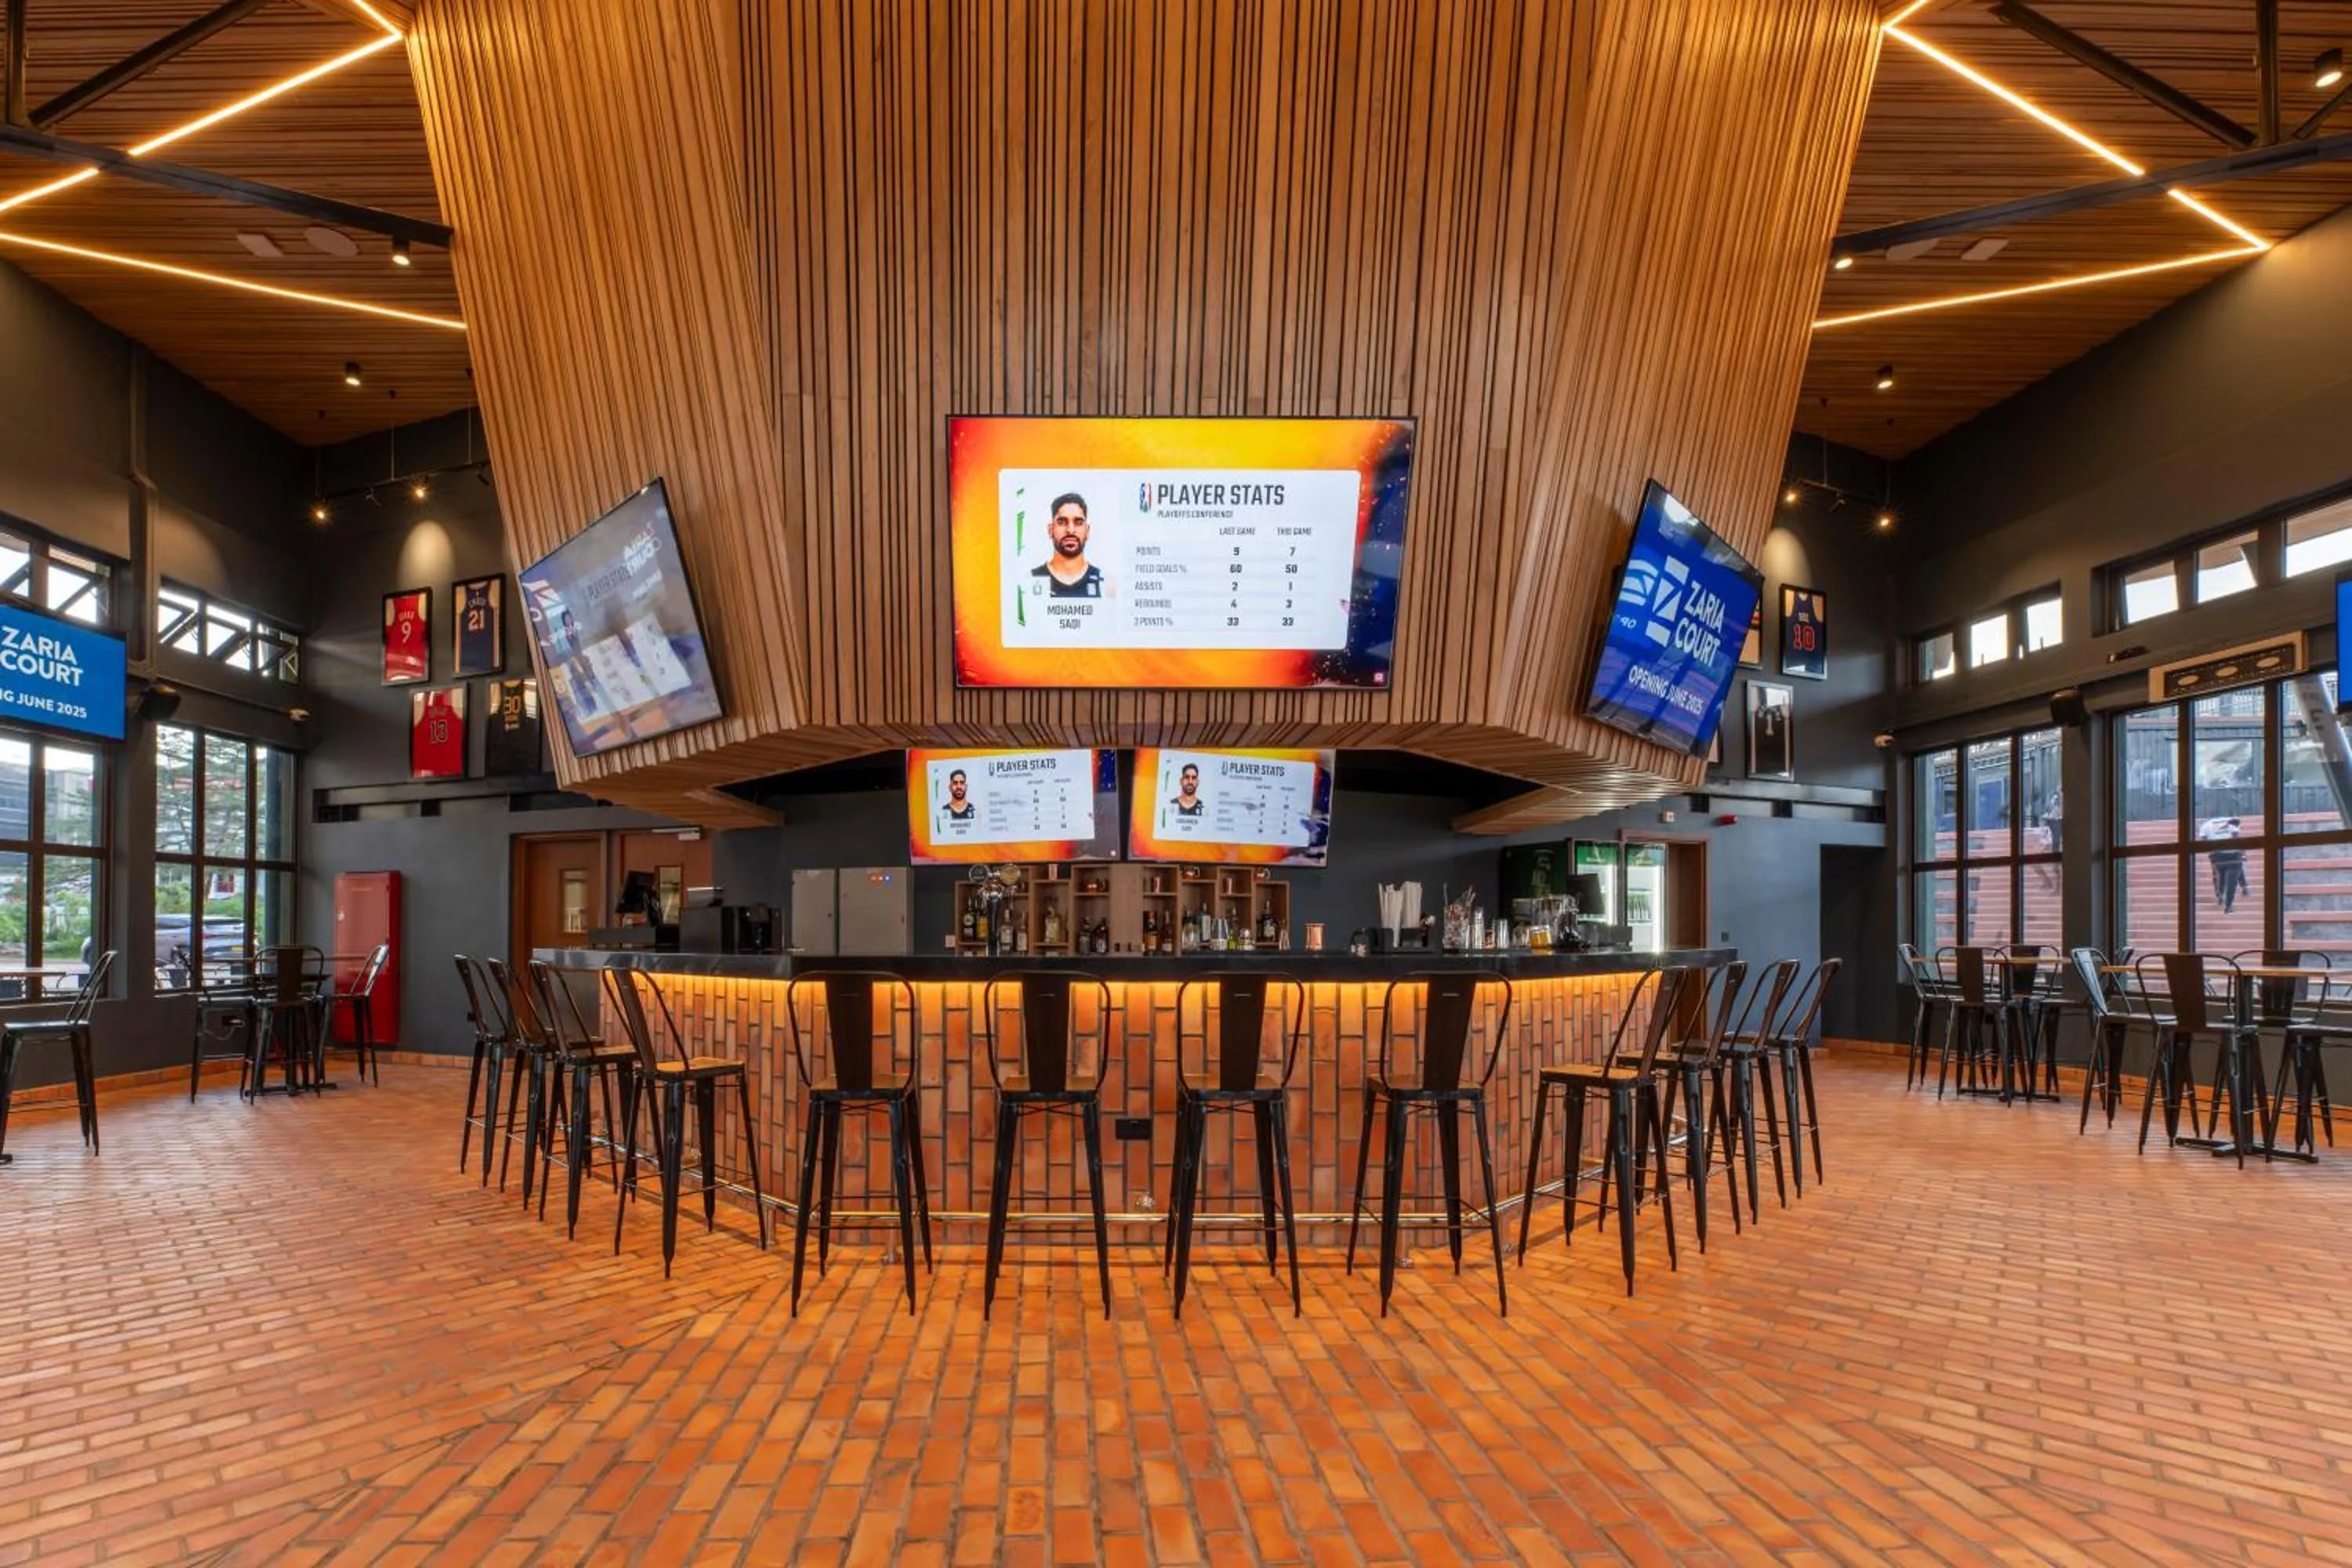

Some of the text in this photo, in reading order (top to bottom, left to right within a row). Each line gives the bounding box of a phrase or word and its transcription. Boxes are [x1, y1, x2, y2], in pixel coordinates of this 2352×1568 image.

[1157, 484, 1285, 506] PLAYER STATS
[1219, 526, 1236, 535] LAST
[1233, 546, 1240, 556] 9
[1290, 546, 1296, 556] 7
[1285, 564, 1298, 574] 50
[1232, 581, 1238, 591] 2
[1047, 604, 1094, 615] MOHAMED
[1683, 581, 1726, 633] ZARIA
[468, 609, 485, 631] 21
[401, 621, 412, 644] 9
[1675, 617, 1721, 667] COURT
[1793, 624, 1815, 652] 10
[1, 625, 78, 666] ZARIA
[0, 649, 84, 687] COURT
[1629, 665, 1669, 699] OPENING
[16, 692, 54, 712] JUNE
[57, 702, 88, 719] 2025
[430, 718, 448, 743] 13
[996, 758, 1056, 772] PLAYER STATS
[1229, 762, 1285, 777] PLAYER STATS
